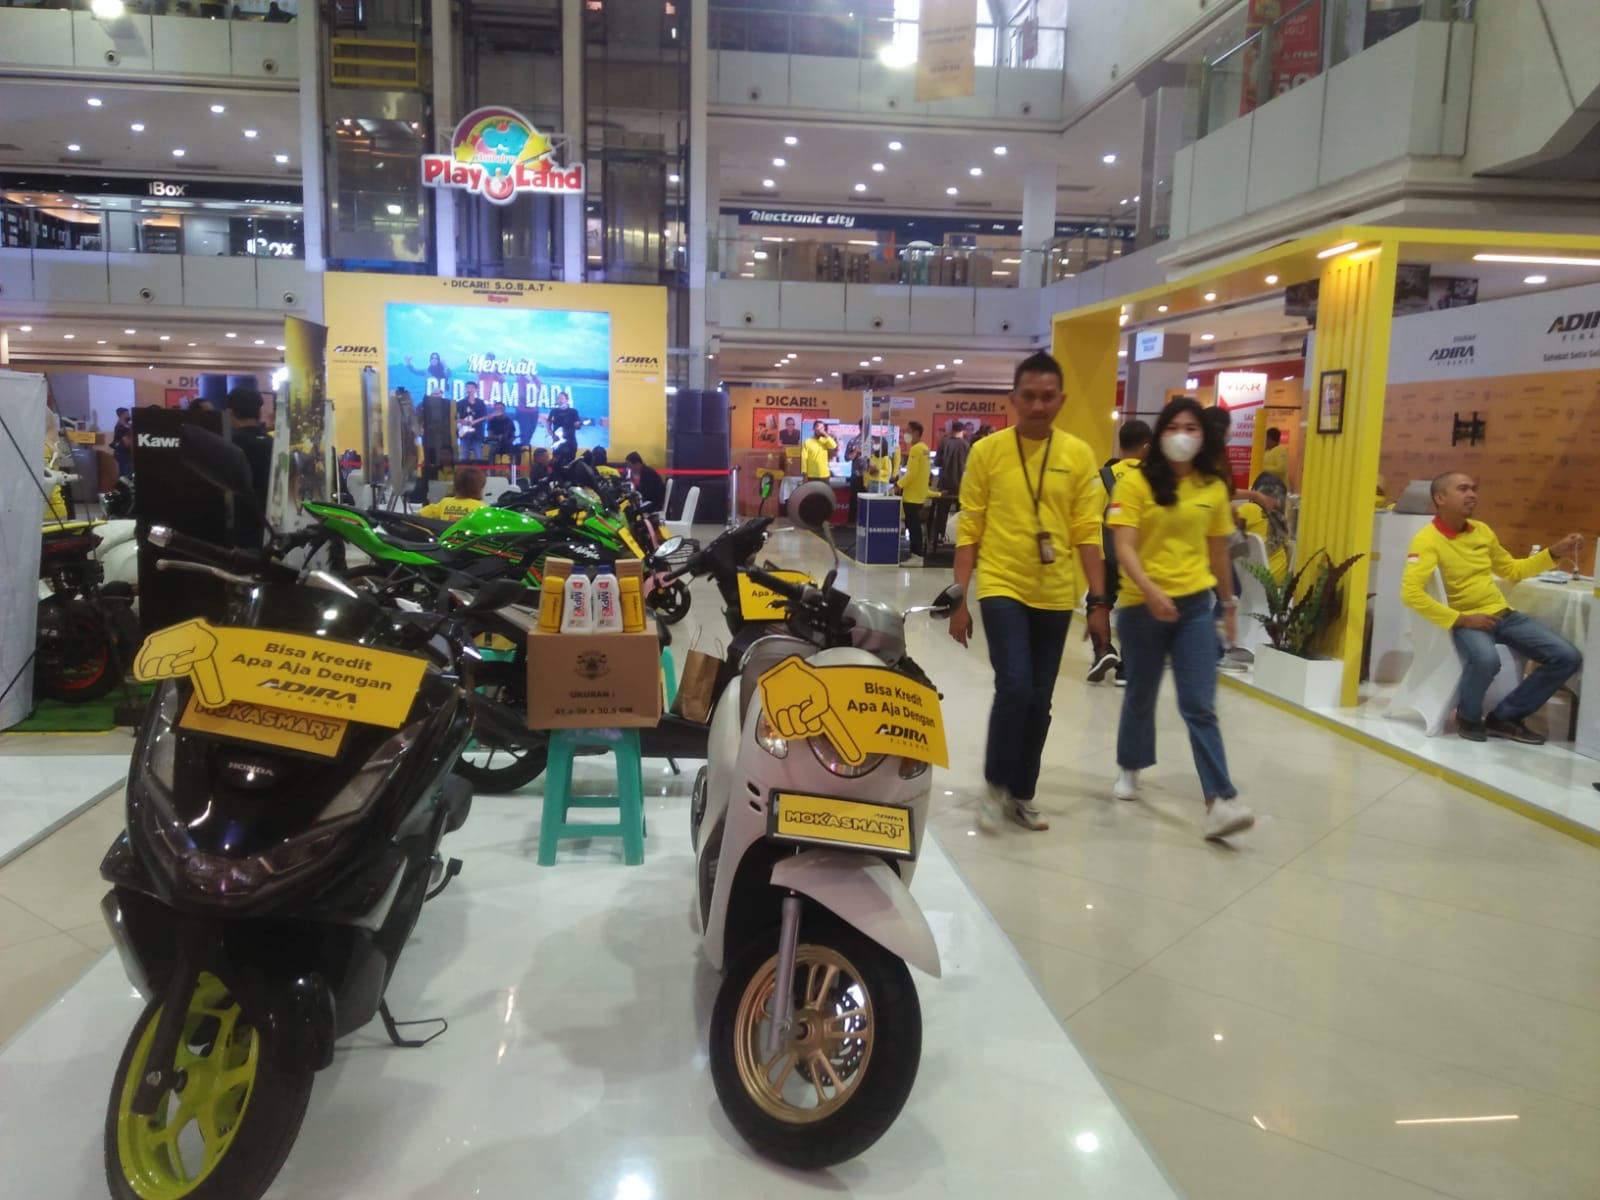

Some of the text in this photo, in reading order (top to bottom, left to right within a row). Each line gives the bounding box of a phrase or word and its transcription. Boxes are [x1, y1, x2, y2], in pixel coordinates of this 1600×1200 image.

[424, 159, 482, 189] Play
[516, 159, 582, 189] Land
[826, 214, 855, 227] city
[467, 353, 538, 376] Merekah
[616, 356, 658, 364] ADIRA
[1429, 345, 1474, 361] ADIRA
[453, 380, 519, 407] DLAM
[766, 396, 817, 407] DICARI!
[946, 401, 996, 412] DICARI!
[265, 642, 373, 672] Bisa Kredit
[232, 654, 393, 691] Apa Aja Dengan
[257, 678, 357, 704] ADIRA
[864, 682, 922, 707] Bisa Kredit
[847, 699, 935, 728] Apa Aja Dengan
[875, 723, 928, 745] ADIRA
[228, 761, 274, 776] HONDA
[785, 809, 904, 839] MOKASMART
